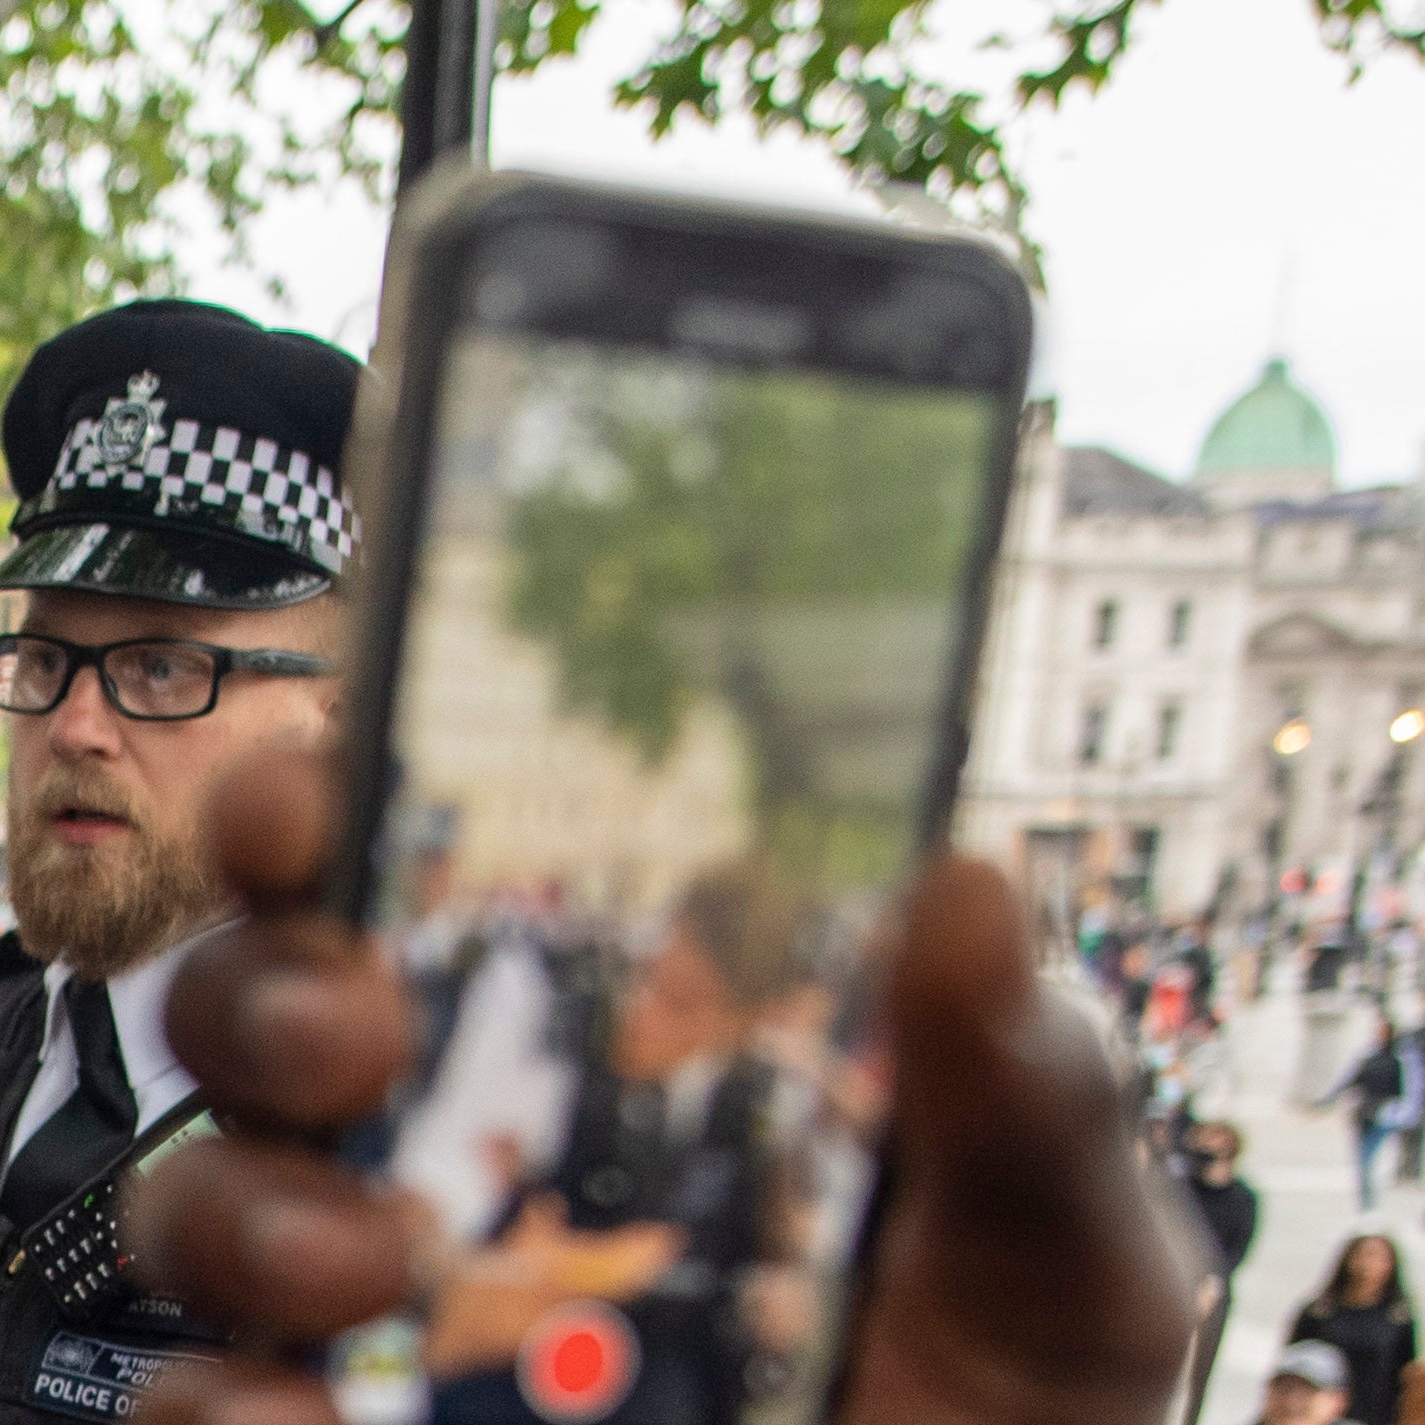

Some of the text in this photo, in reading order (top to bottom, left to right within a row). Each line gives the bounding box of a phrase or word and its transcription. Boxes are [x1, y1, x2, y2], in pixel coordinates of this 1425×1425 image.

[115, 1368, 155, 1388] POL
[33, 1373, 143, 1417] POLICE OF
